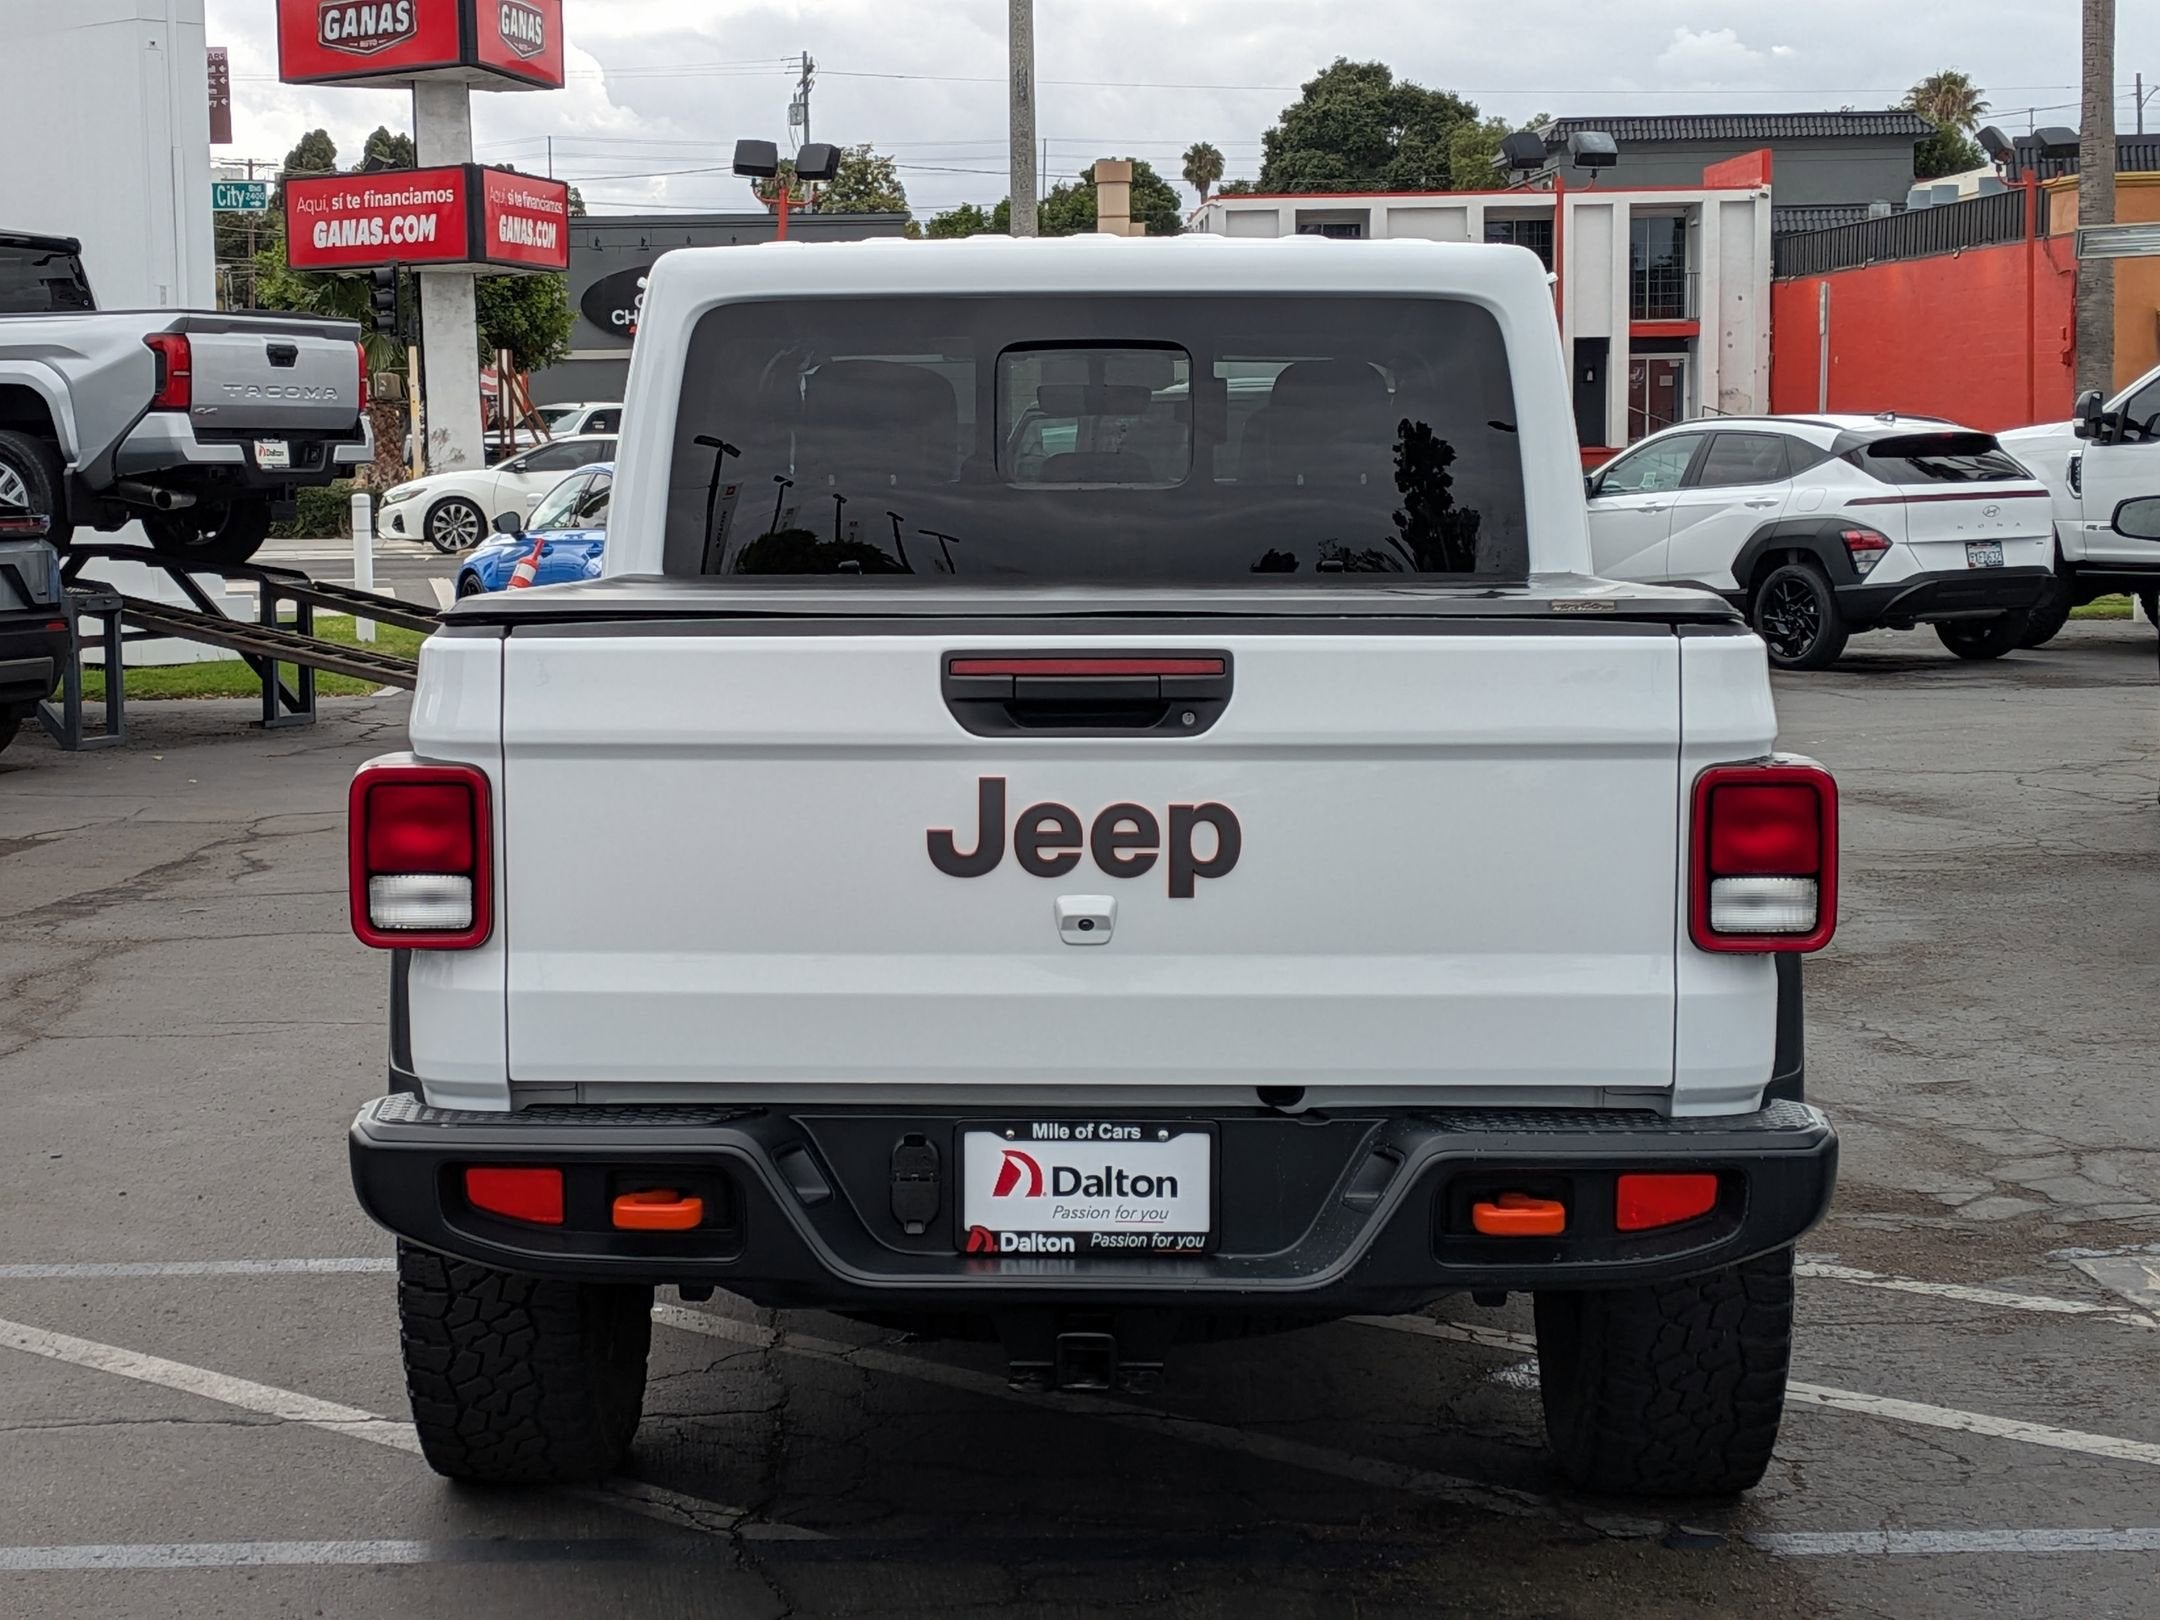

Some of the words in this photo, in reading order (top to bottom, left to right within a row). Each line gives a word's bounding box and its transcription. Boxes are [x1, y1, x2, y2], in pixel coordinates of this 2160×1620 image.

[324, 1, 411, 41] GANAS
[501, 4, 542, 45] GANAS
[217, 185, 245, 208] City
[245, 192, 265, 201] 2400
[331, 192, 344, 210] sí
[346, 193, 361, 210] te
[363, 186, 454, 208] financiamos
[515, 191, 522, 208] te
[312, 213, 437, 249] GANAS.COM
[499, 214, 557, 250] GANAS.COM
[611, 309, 639, 325] CH
[223, 383, 339, 401] TACOMA
[926, 776, 1242, 899] Jeep
[1032, 1123, 1070, 1139] Mile
[1075, 1123, 1094, 1139] of
[1098, 1124, 1142, 1140] Cars
[1052, 1166, 1178, 1198] Dalton
[1052, 1205, 1110, 1220] Passion
[1115, 1205, 1138, 1220] for
[1140, 1207, 1169, 1222] you
[1000, 1232, 1075, 1253] Dalton
[1090, 1232, 1149, 1248] Passion
[1152, 1233, 1174, 1248] for
[1176, 1236, 1206, 1250] you
